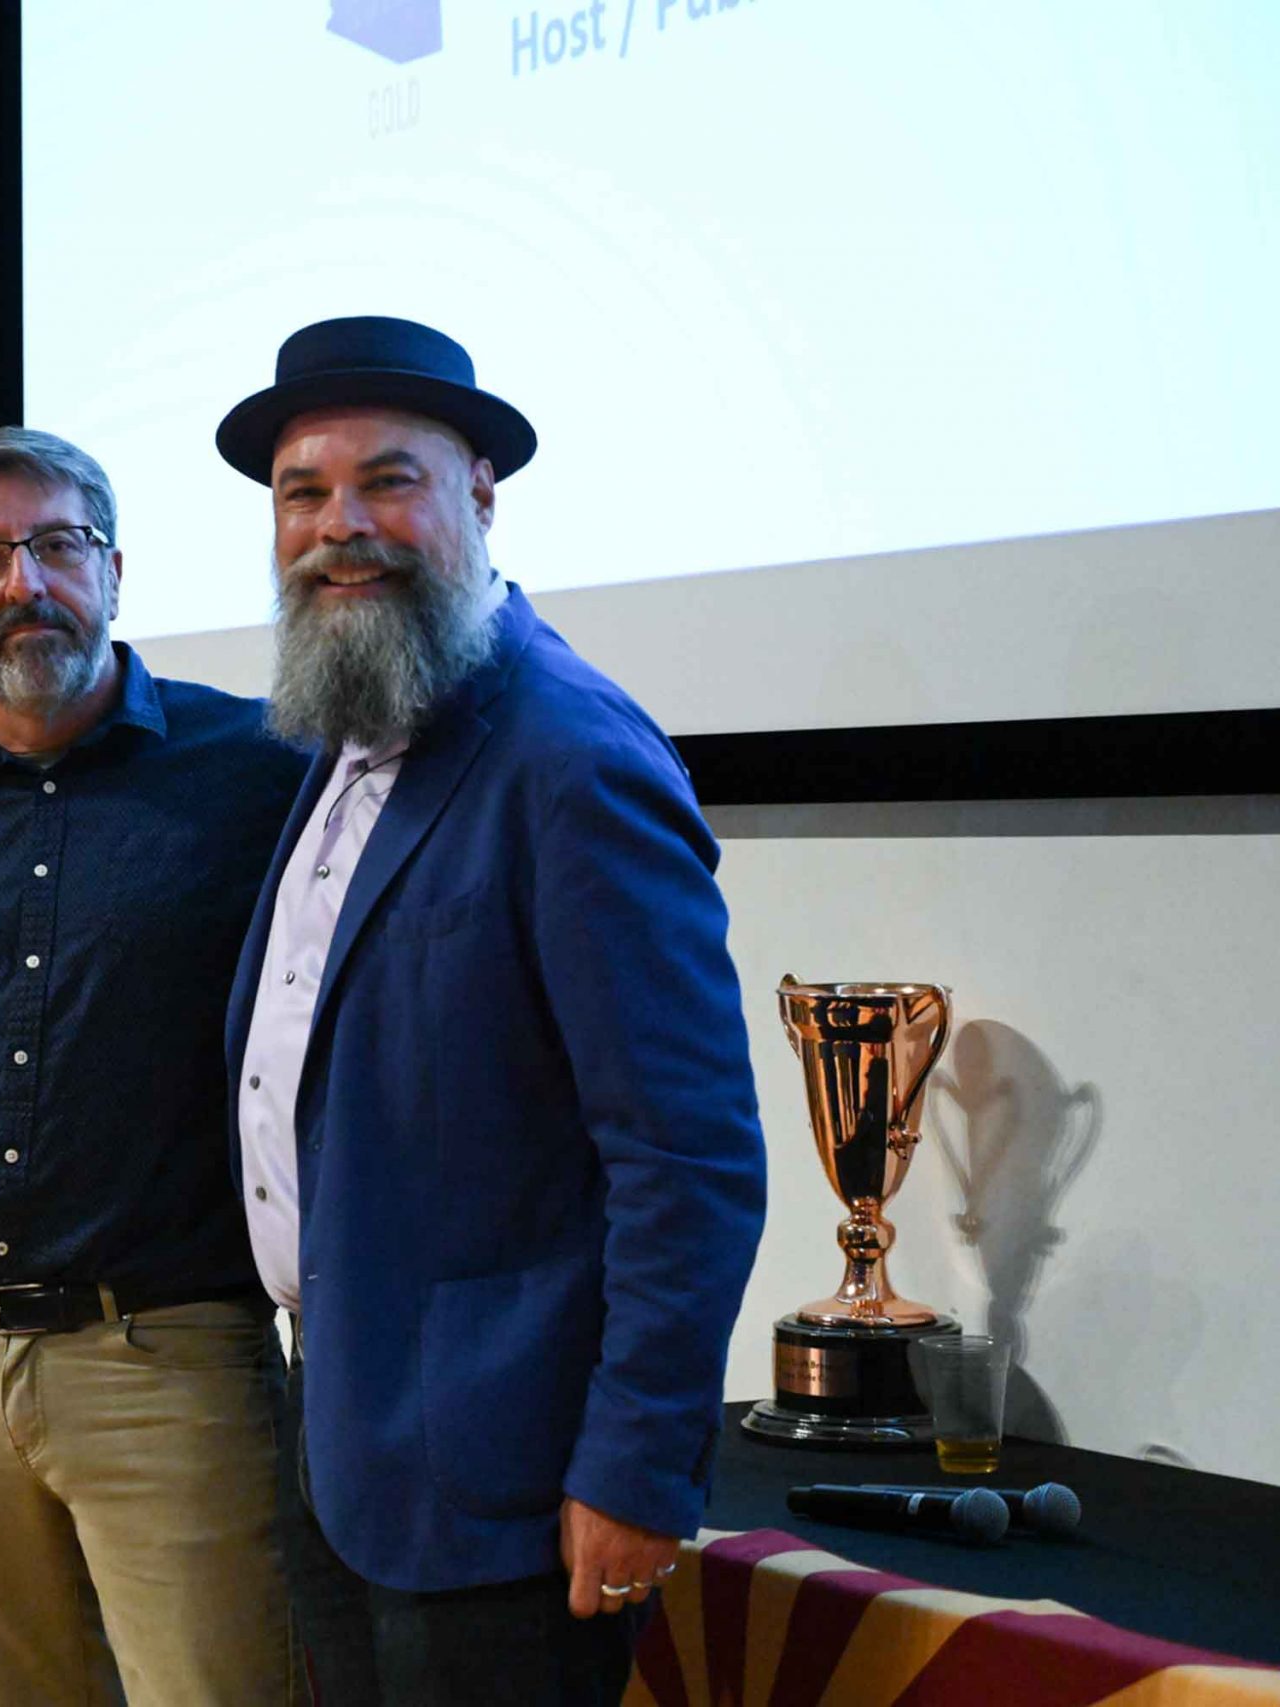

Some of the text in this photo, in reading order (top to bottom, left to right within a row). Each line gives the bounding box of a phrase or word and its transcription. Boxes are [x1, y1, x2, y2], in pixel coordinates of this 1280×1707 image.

[511, 0, 607, 76] Host
[618, 0, 637, 59] /
[367, 76, 420, 139] GOLD
